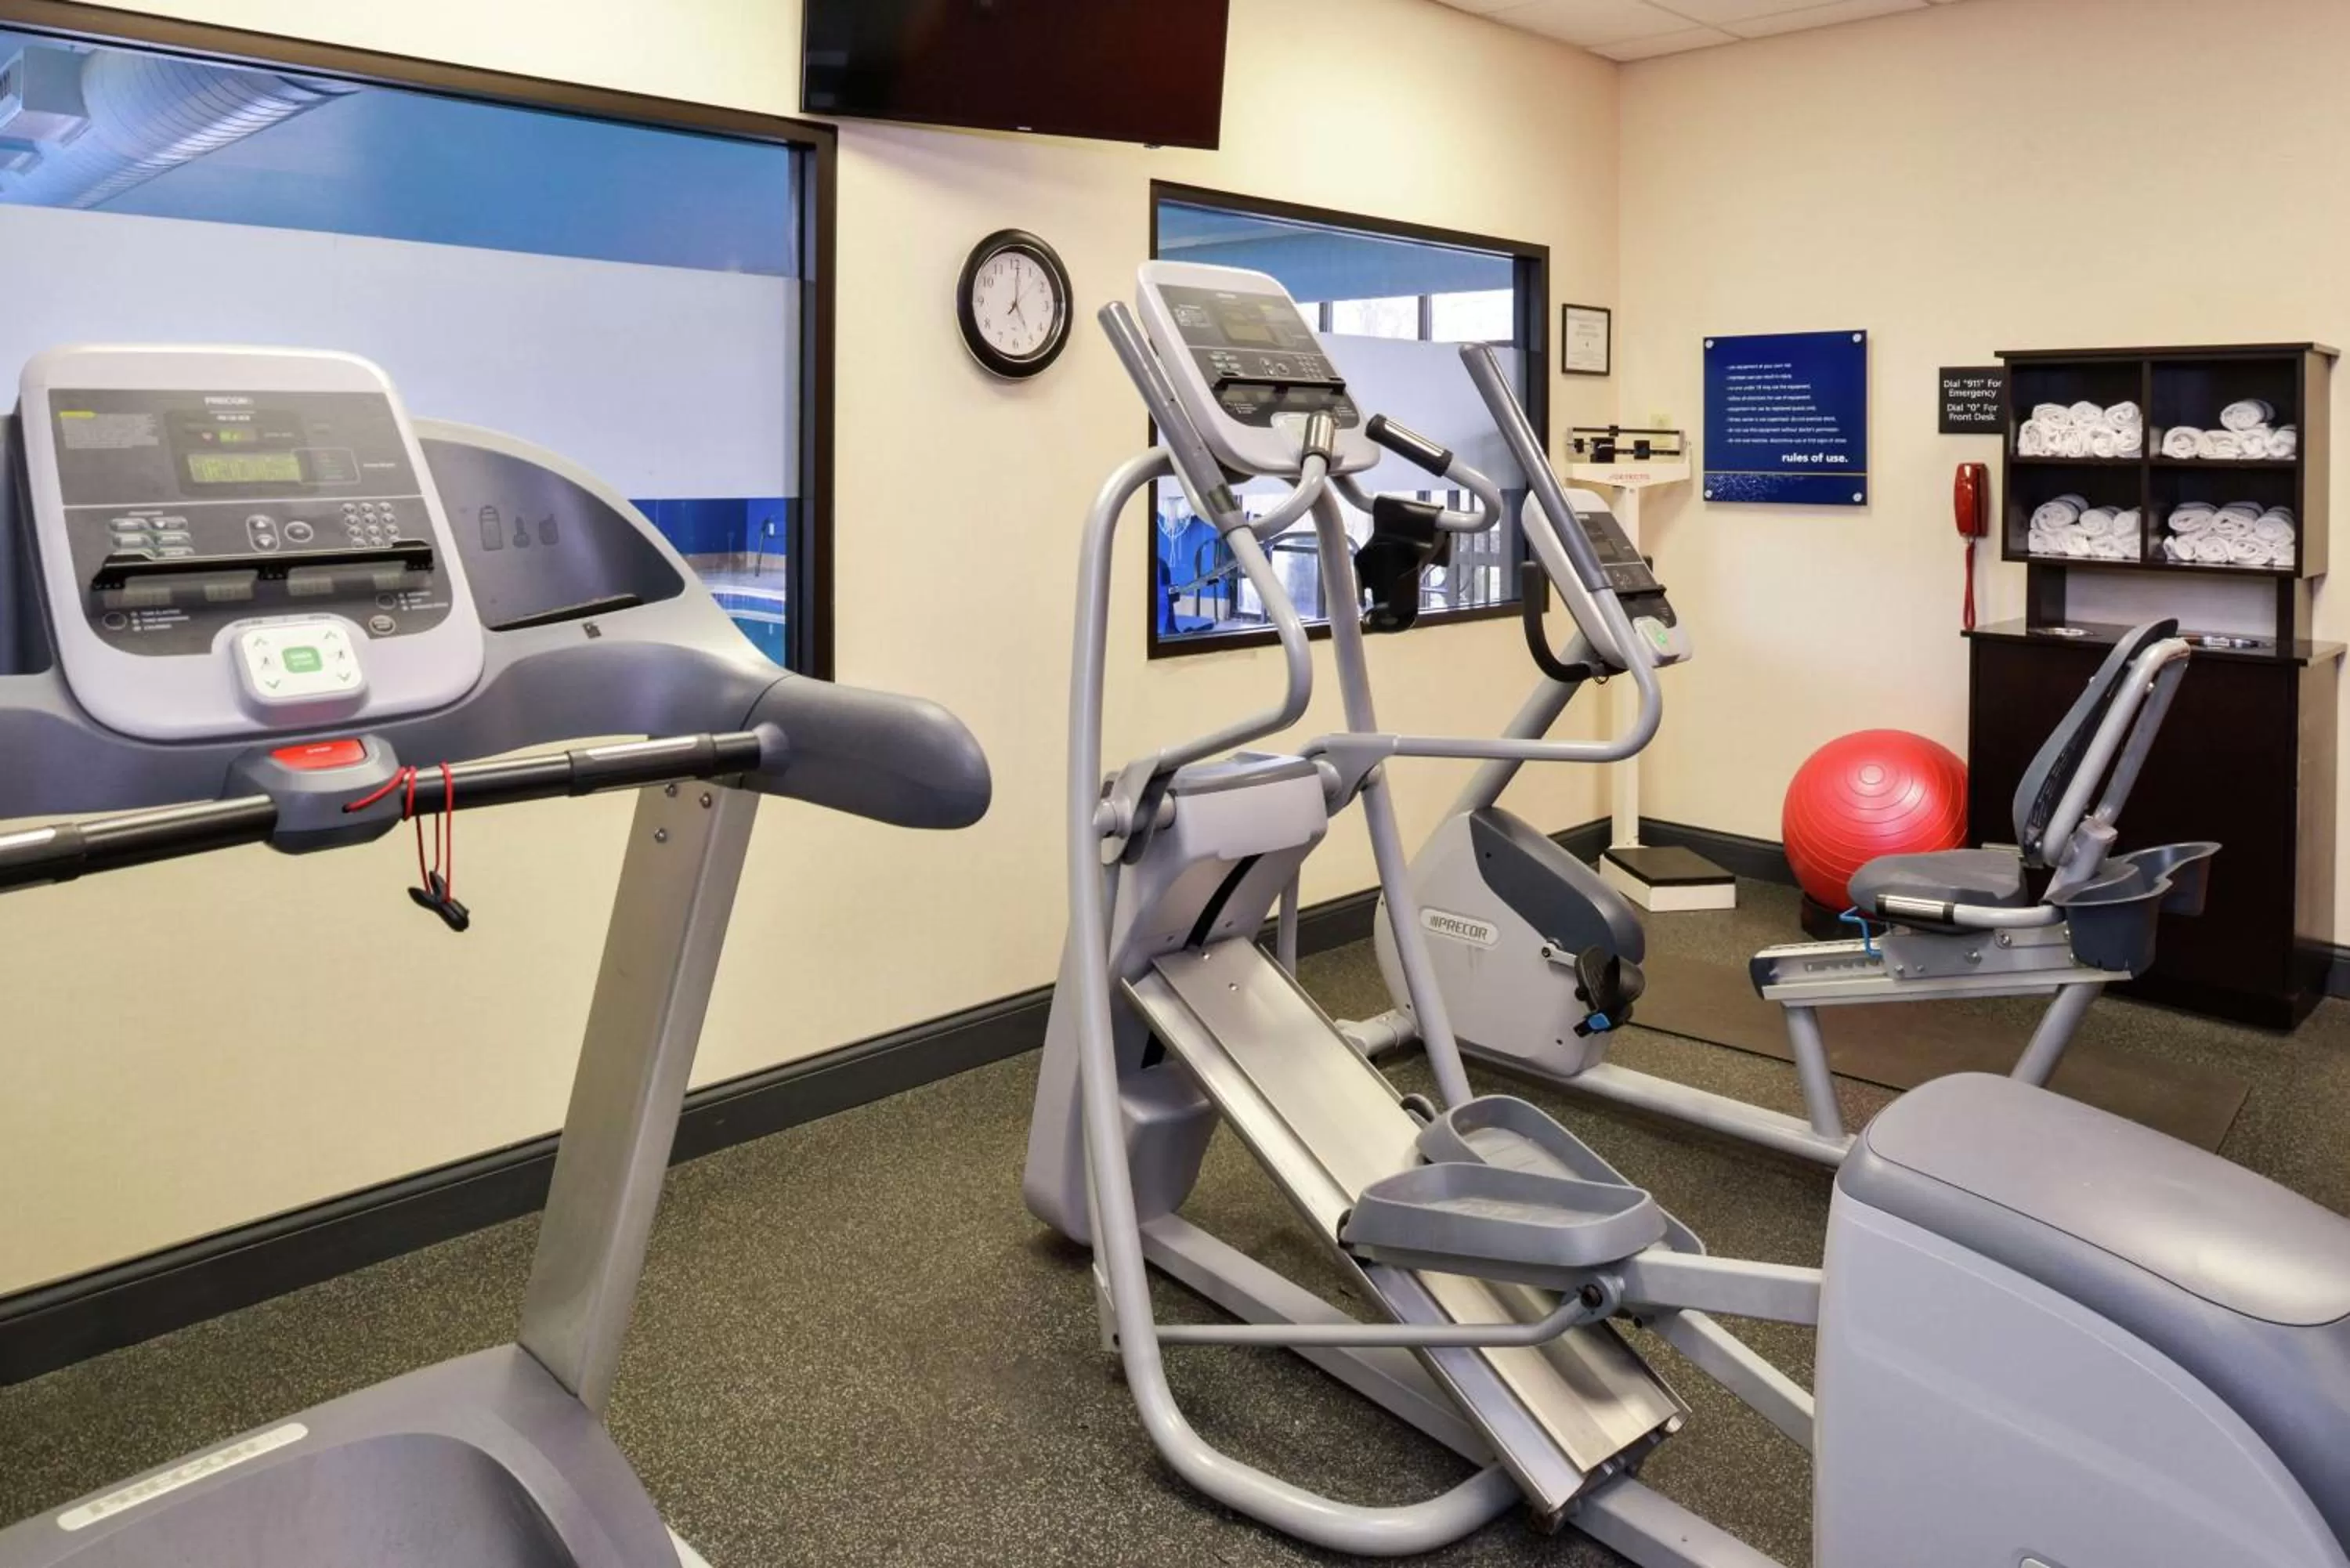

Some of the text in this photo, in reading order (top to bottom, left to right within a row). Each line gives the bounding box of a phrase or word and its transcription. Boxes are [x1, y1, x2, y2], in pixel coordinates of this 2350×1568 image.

[1010, 258, 1021, 270] 12
[995, 264, 1003, 275] 11
[1028, 266, 1032, 276] 1
[983, 276, 994, 288] 10
[1943, 379, 1961, 388] Dial
[1987, 378, 2002, 388] For
[1948, 389, 1997, 399] Emergency
[1947, 403, 1964, 412] Dial
[1781, 453, 1849, 463] rules of use.
[1438, 917, 1488, 940] PRECOR
